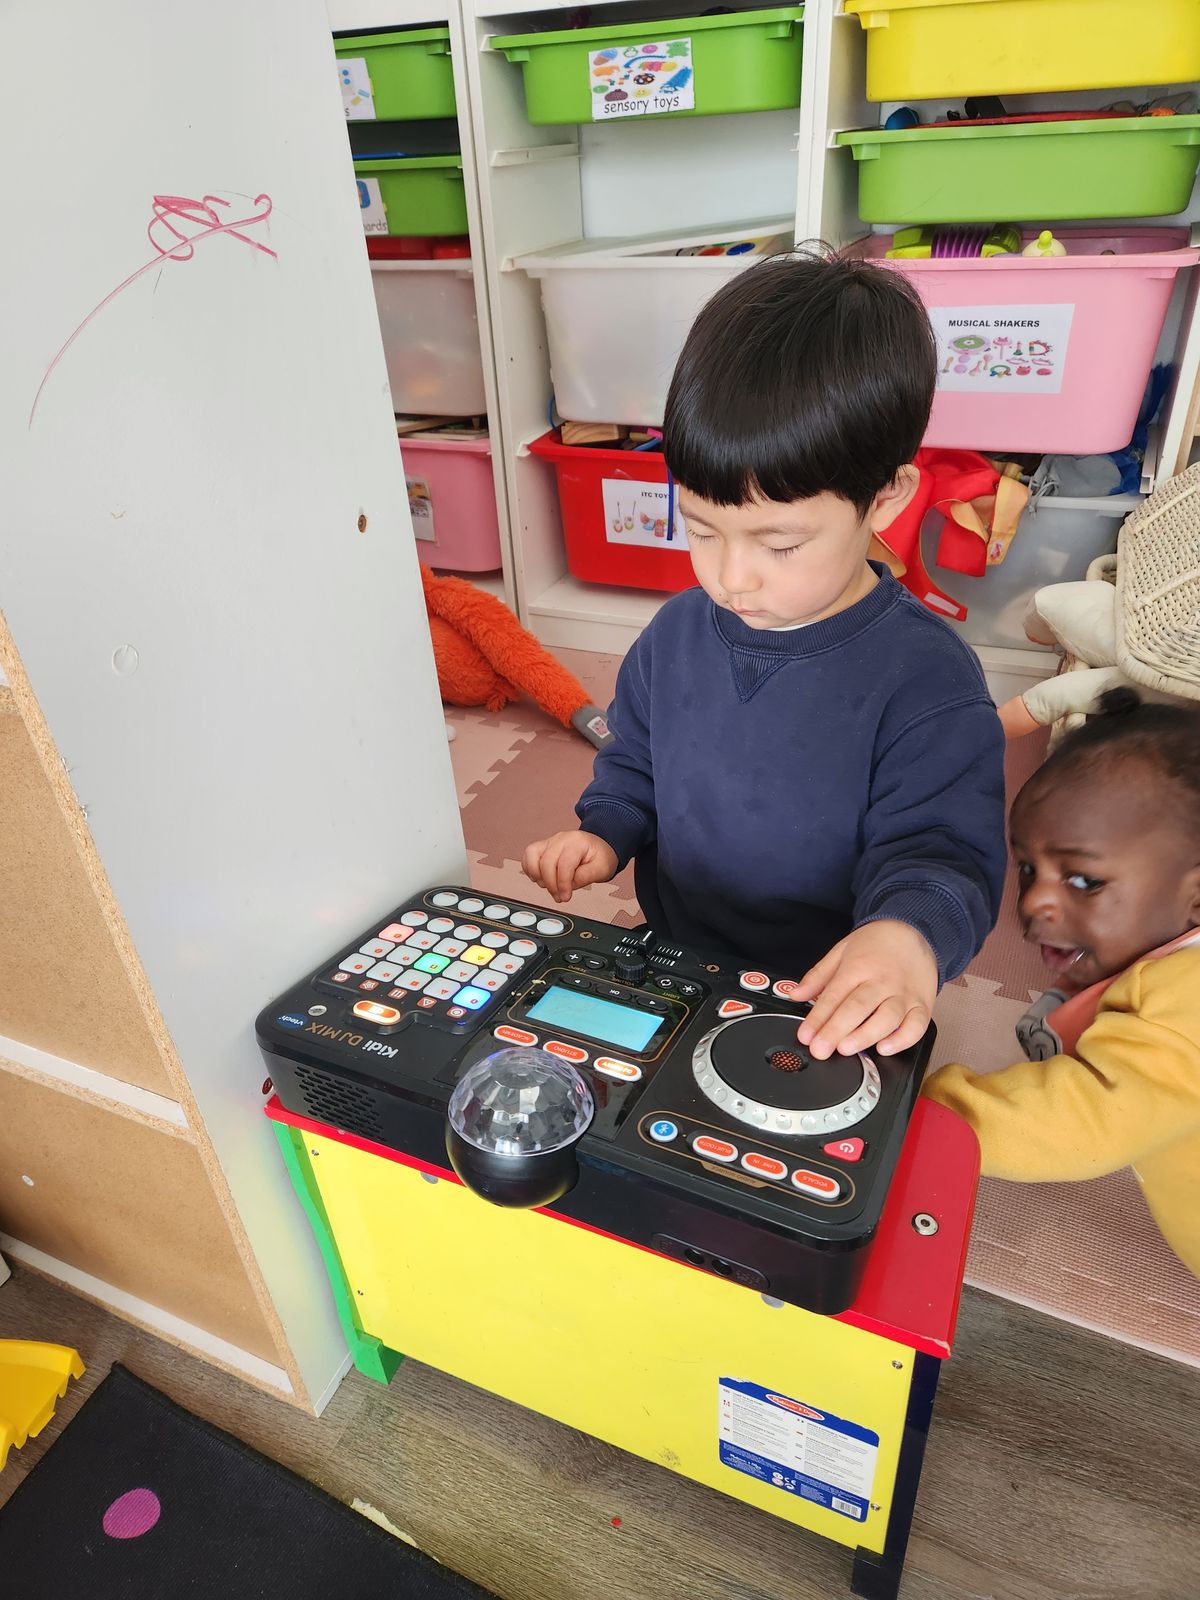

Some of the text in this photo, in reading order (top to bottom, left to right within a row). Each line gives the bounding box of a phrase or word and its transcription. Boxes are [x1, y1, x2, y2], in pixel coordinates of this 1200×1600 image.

[604, 95, 680, 115] sensory toys
[948, 319, 1040, 328] MUSICAL SHAKERS
[609, 988, 620, 996] OK
[304, 1021, 399, 1059] Kidi DJ MIX
[802, 1175, 829, 1188] VOCALS
